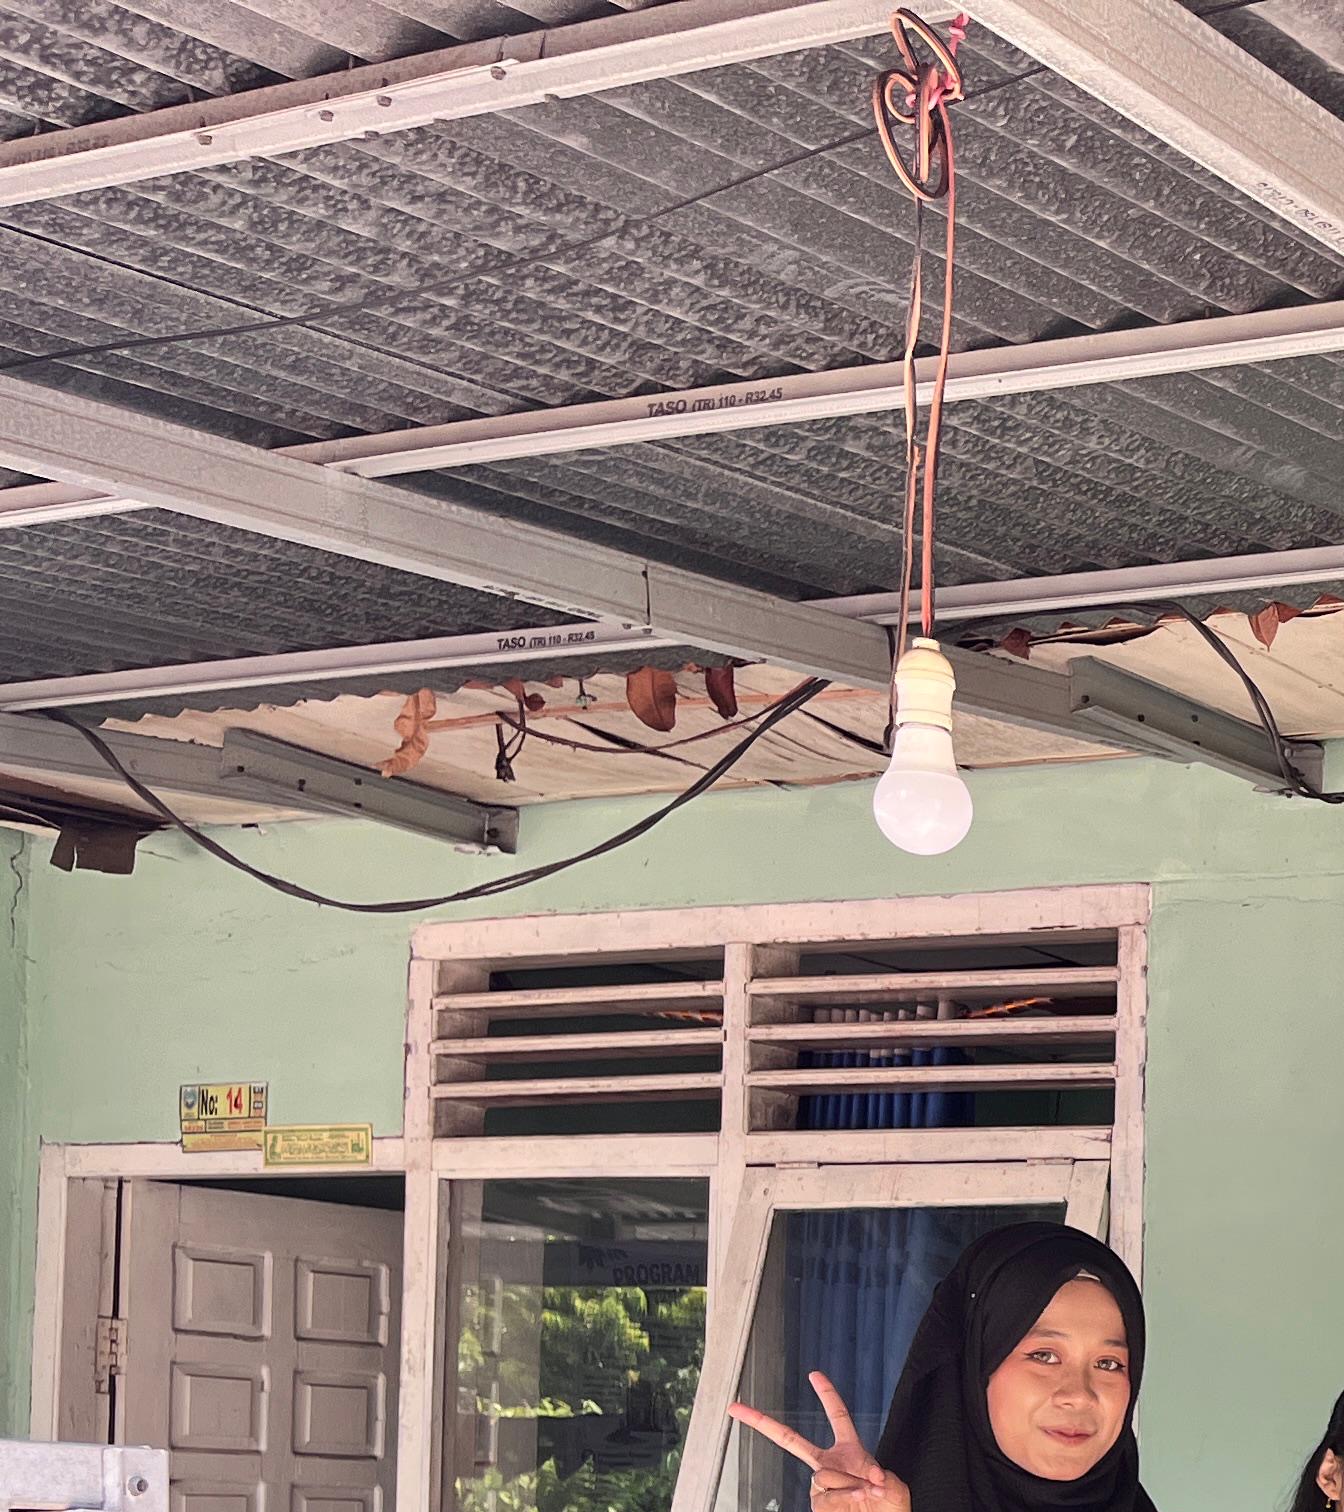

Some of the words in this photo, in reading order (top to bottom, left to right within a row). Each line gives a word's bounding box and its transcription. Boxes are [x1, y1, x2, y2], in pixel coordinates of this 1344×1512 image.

[648, 400, 687, 417] TASO
[692, 398, 716, 412] (TR)
[720, 394, 736, 408] 110
[745, 388, 783, 403] R32.45
[498, 636, 526, 650] TASO
[549, 633, 561, 645] 110
[201, 1088, 218, 1116] No:
[227, 1086, 243, 1115] 14
[613, 1263, 699, 1285] PROGRAM
